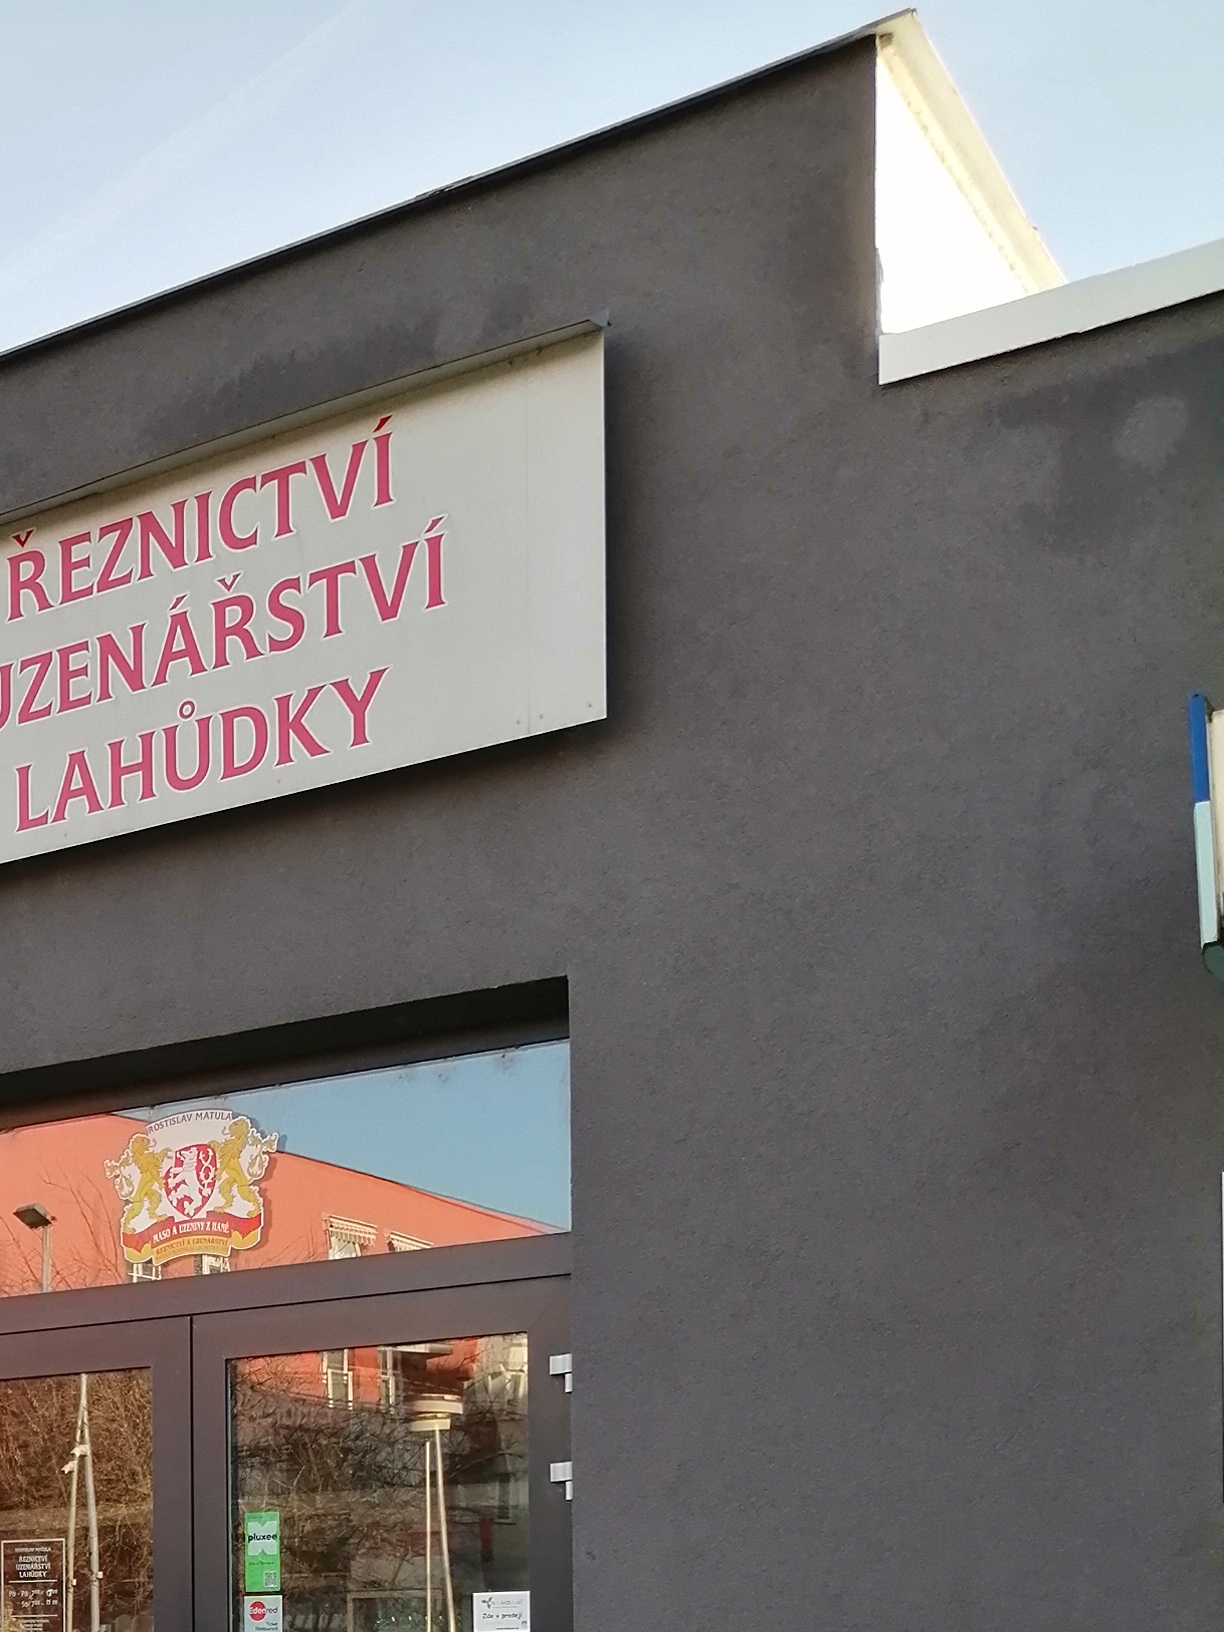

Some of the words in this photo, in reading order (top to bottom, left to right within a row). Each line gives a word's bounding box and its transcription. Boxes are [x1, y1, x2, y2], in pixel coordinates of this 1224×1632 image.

[6, 414, 395, 625] ŘEZNICTVÍ
[13, 668, 390, 833] LAHŮDKY
[148, 1113, 193, 1134] ROSTISLAV
[195, 1111, 232, 1122] MATULA
[153, 1229, 171, 1244] MASO
[172, 1225, 177, 1235] A
[248, 1533, 277, 1543] pluxee
[249, 1605, 278, 1615] Edenred
